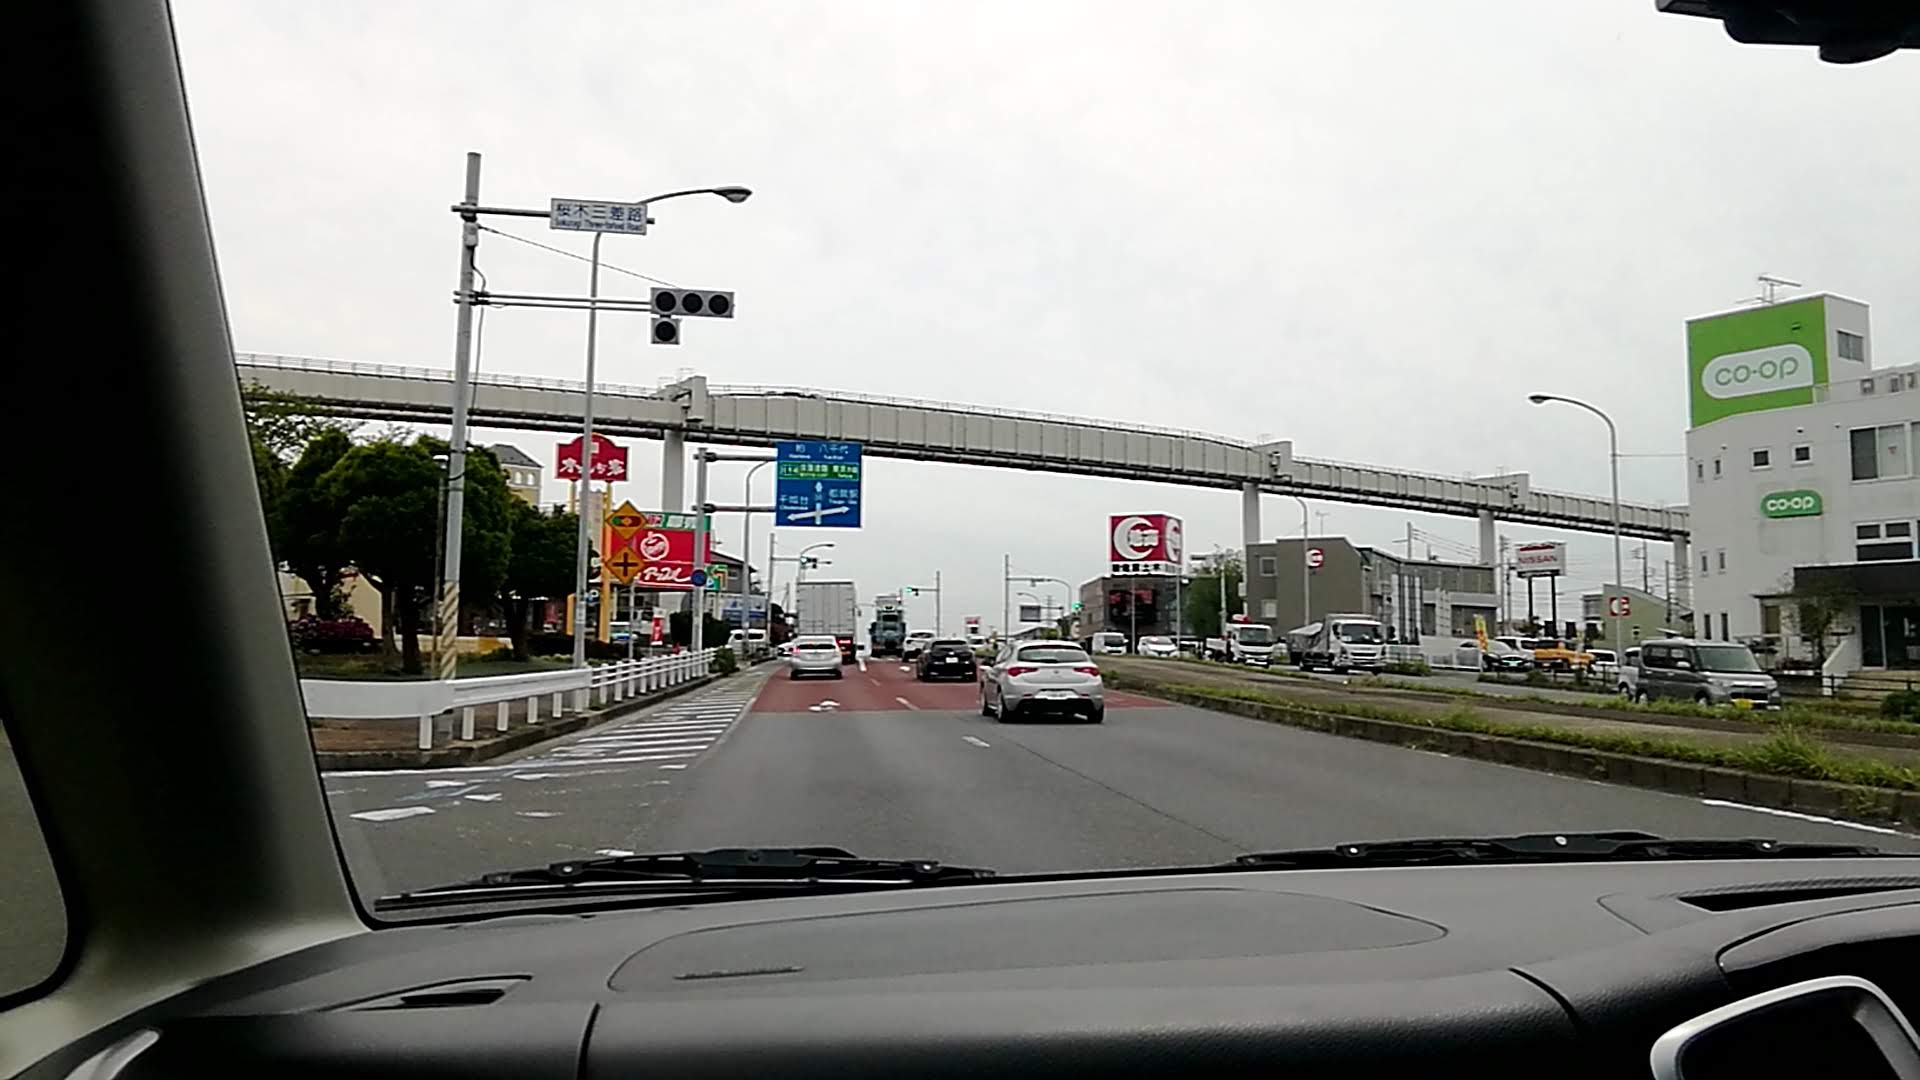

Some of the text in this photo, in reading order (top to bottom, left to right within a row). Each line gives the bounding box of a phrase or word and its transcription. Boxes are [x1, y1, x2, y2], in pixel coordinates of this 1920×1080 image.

[557, 204, 642, 222] 桜木三差路
[1518, 555, 1557, 564] NISSAN
